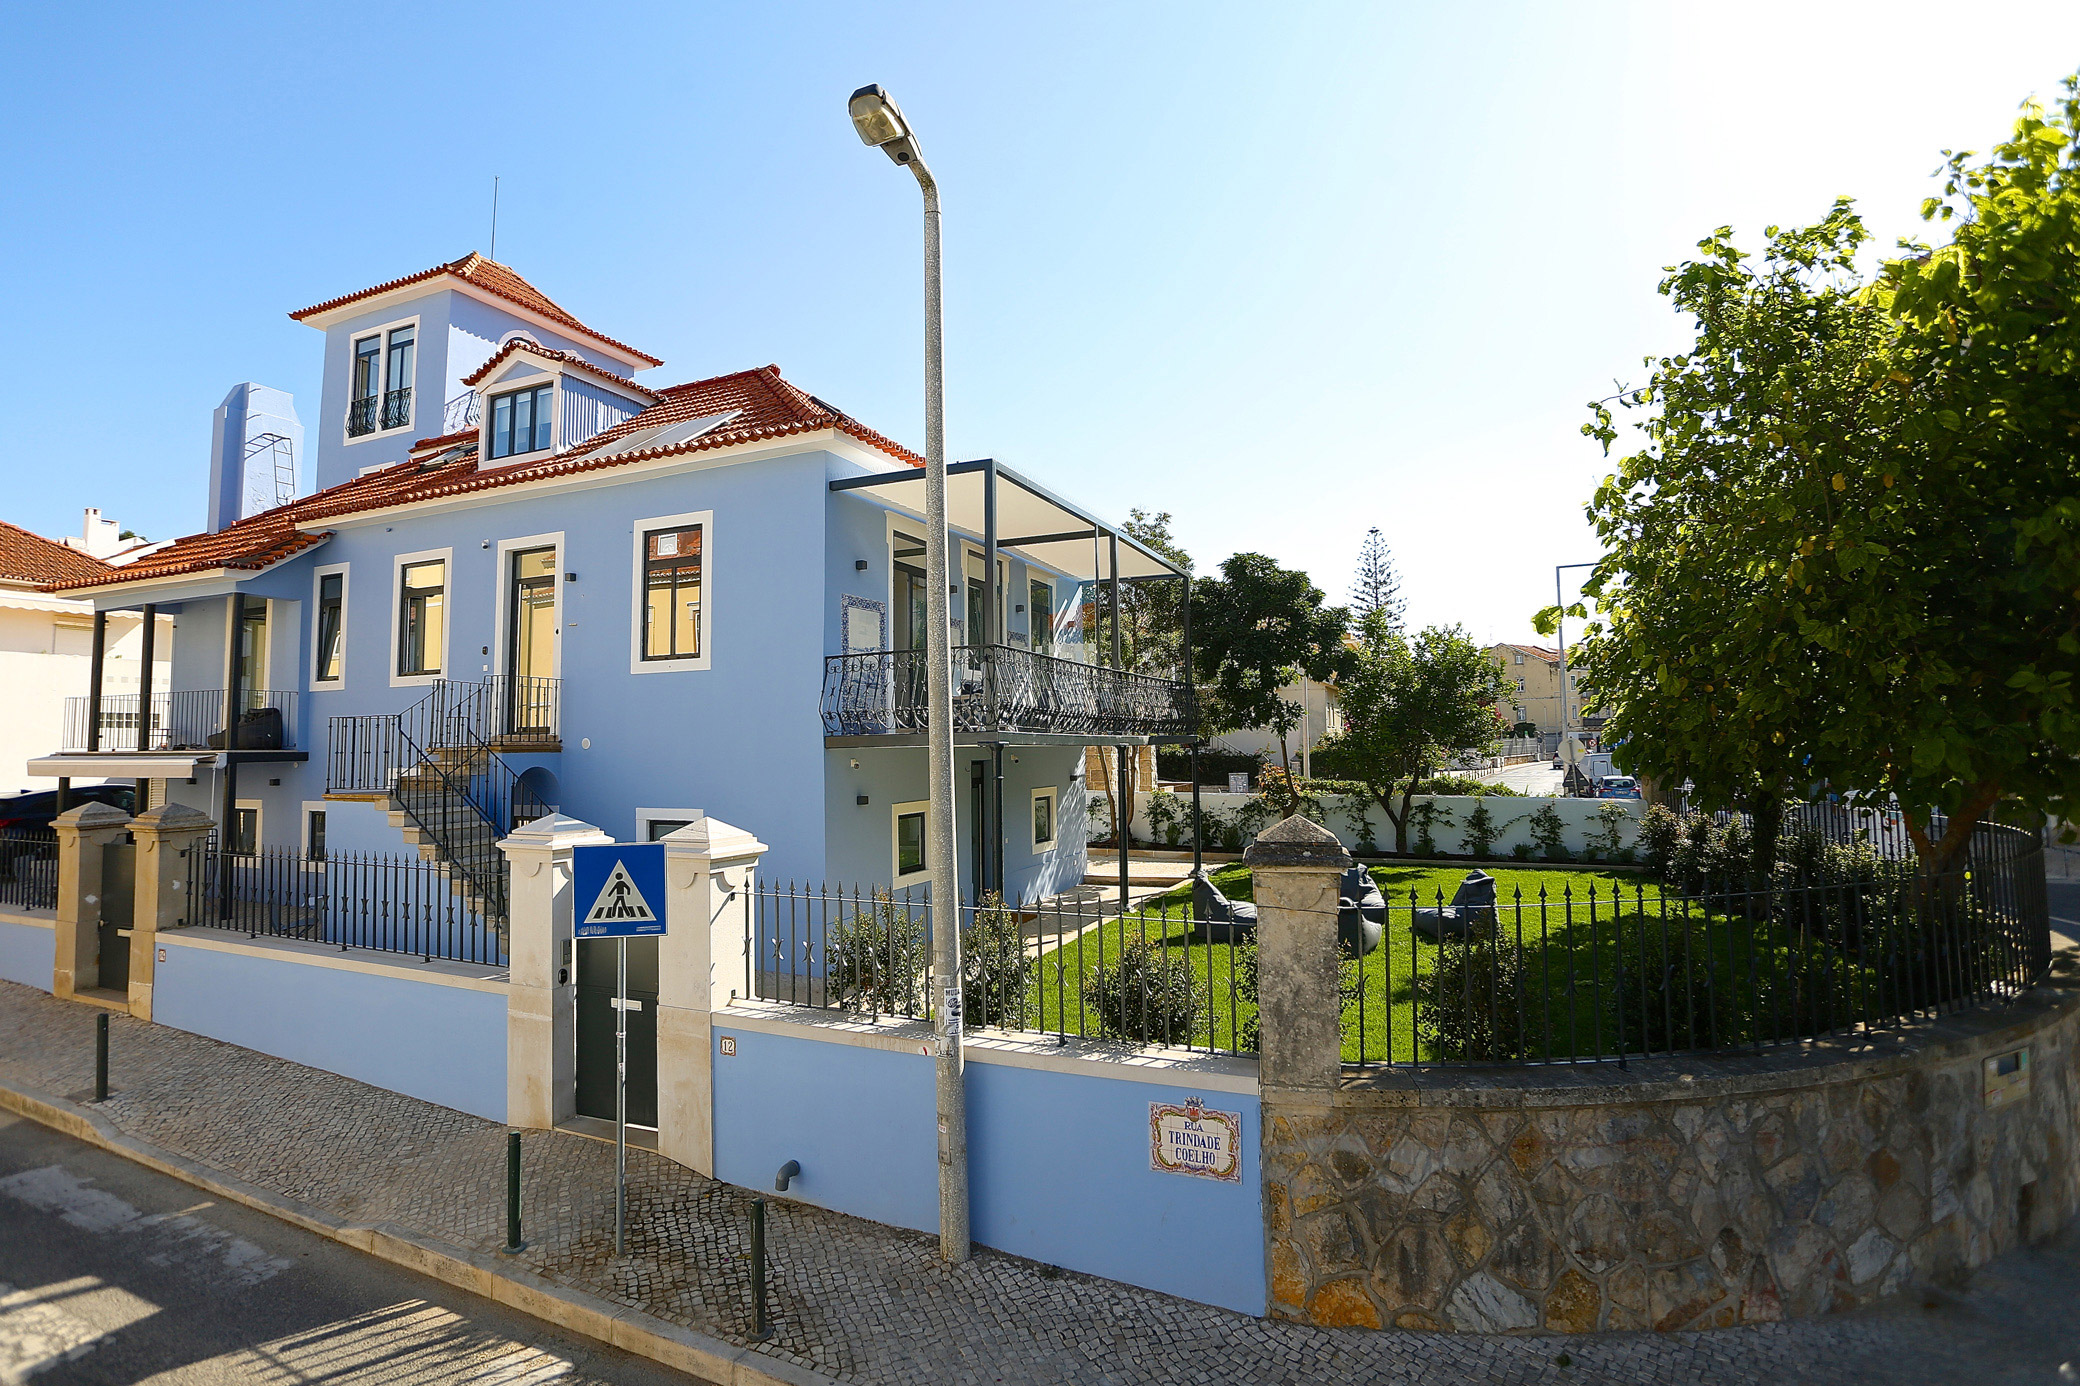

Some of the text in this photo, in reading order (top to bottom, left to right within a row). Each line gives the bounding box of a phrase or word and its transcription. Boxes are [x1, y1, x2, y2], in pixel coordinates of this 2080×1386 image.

[724, 1041, 733, 1051] 12
[1184, 1121, 1204, 1132] RUA
[1169, 1131, 1220, 1150] TRINDADE
[1175, 1147, 1215, 1165] COELHO
